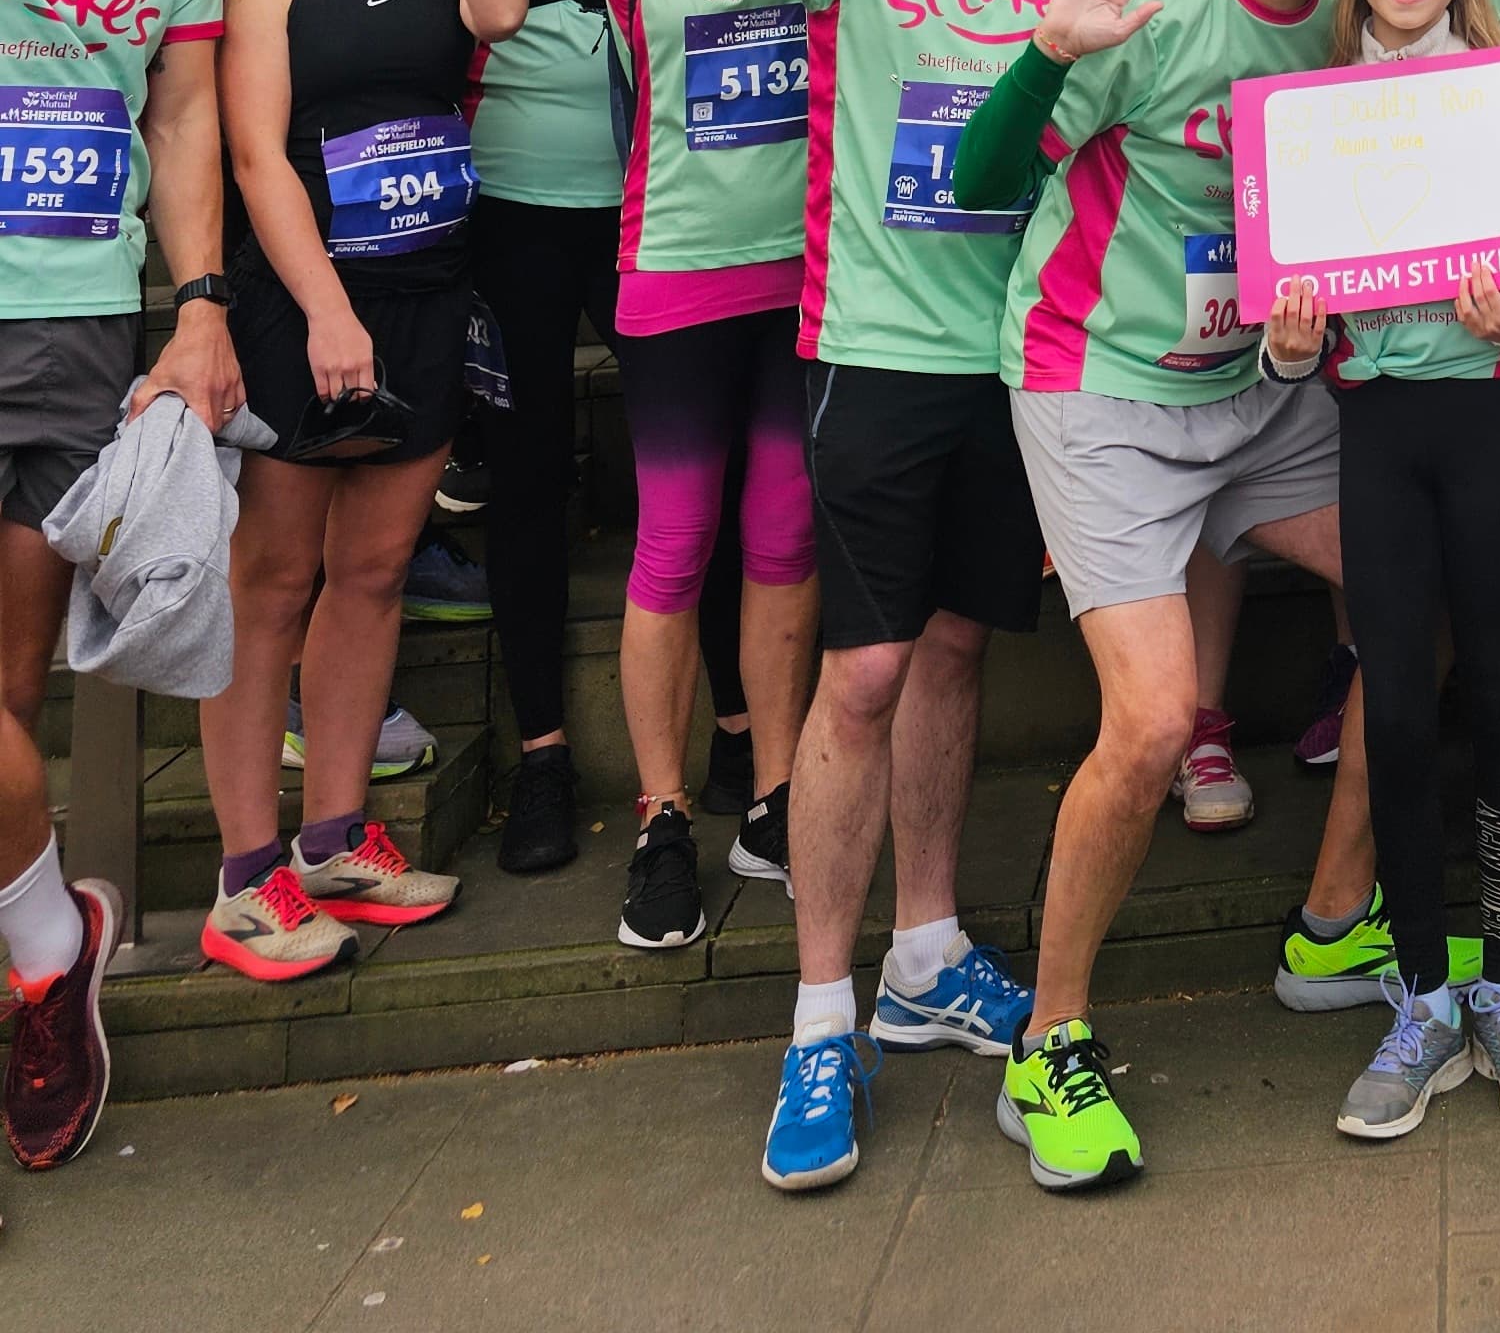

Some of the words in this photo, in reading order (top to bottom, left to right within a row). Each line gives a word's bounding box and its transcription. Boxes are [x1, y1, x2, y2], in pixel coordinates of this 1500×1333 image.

[735, 27, 789, 43] SHEFFIELD
[917, 52, 993, 74] Sheffield's
[720, 57, 809, 102] 5132
[40, 91, 78, 102] Sheffield
[40, 99, 71, 109] Mutual
[21, 110, 83, 122] SHEFFIELD
[84, 111, 105, 124] 10K
[377, 139, 426, 155] SHEFFIELD
[427, 136, 446, 148] 10K
[0, 147, 99, 186] 1532
[25, 192, 65, 208] PETE
[379, 171, 444, 211] 504
[390, 211, 431, 230] LYDIA
[923, 215, 936, 224] ALL
[1324, 264, 1400, 296] TEAM
[1407, 258, 1438, 287] ST
